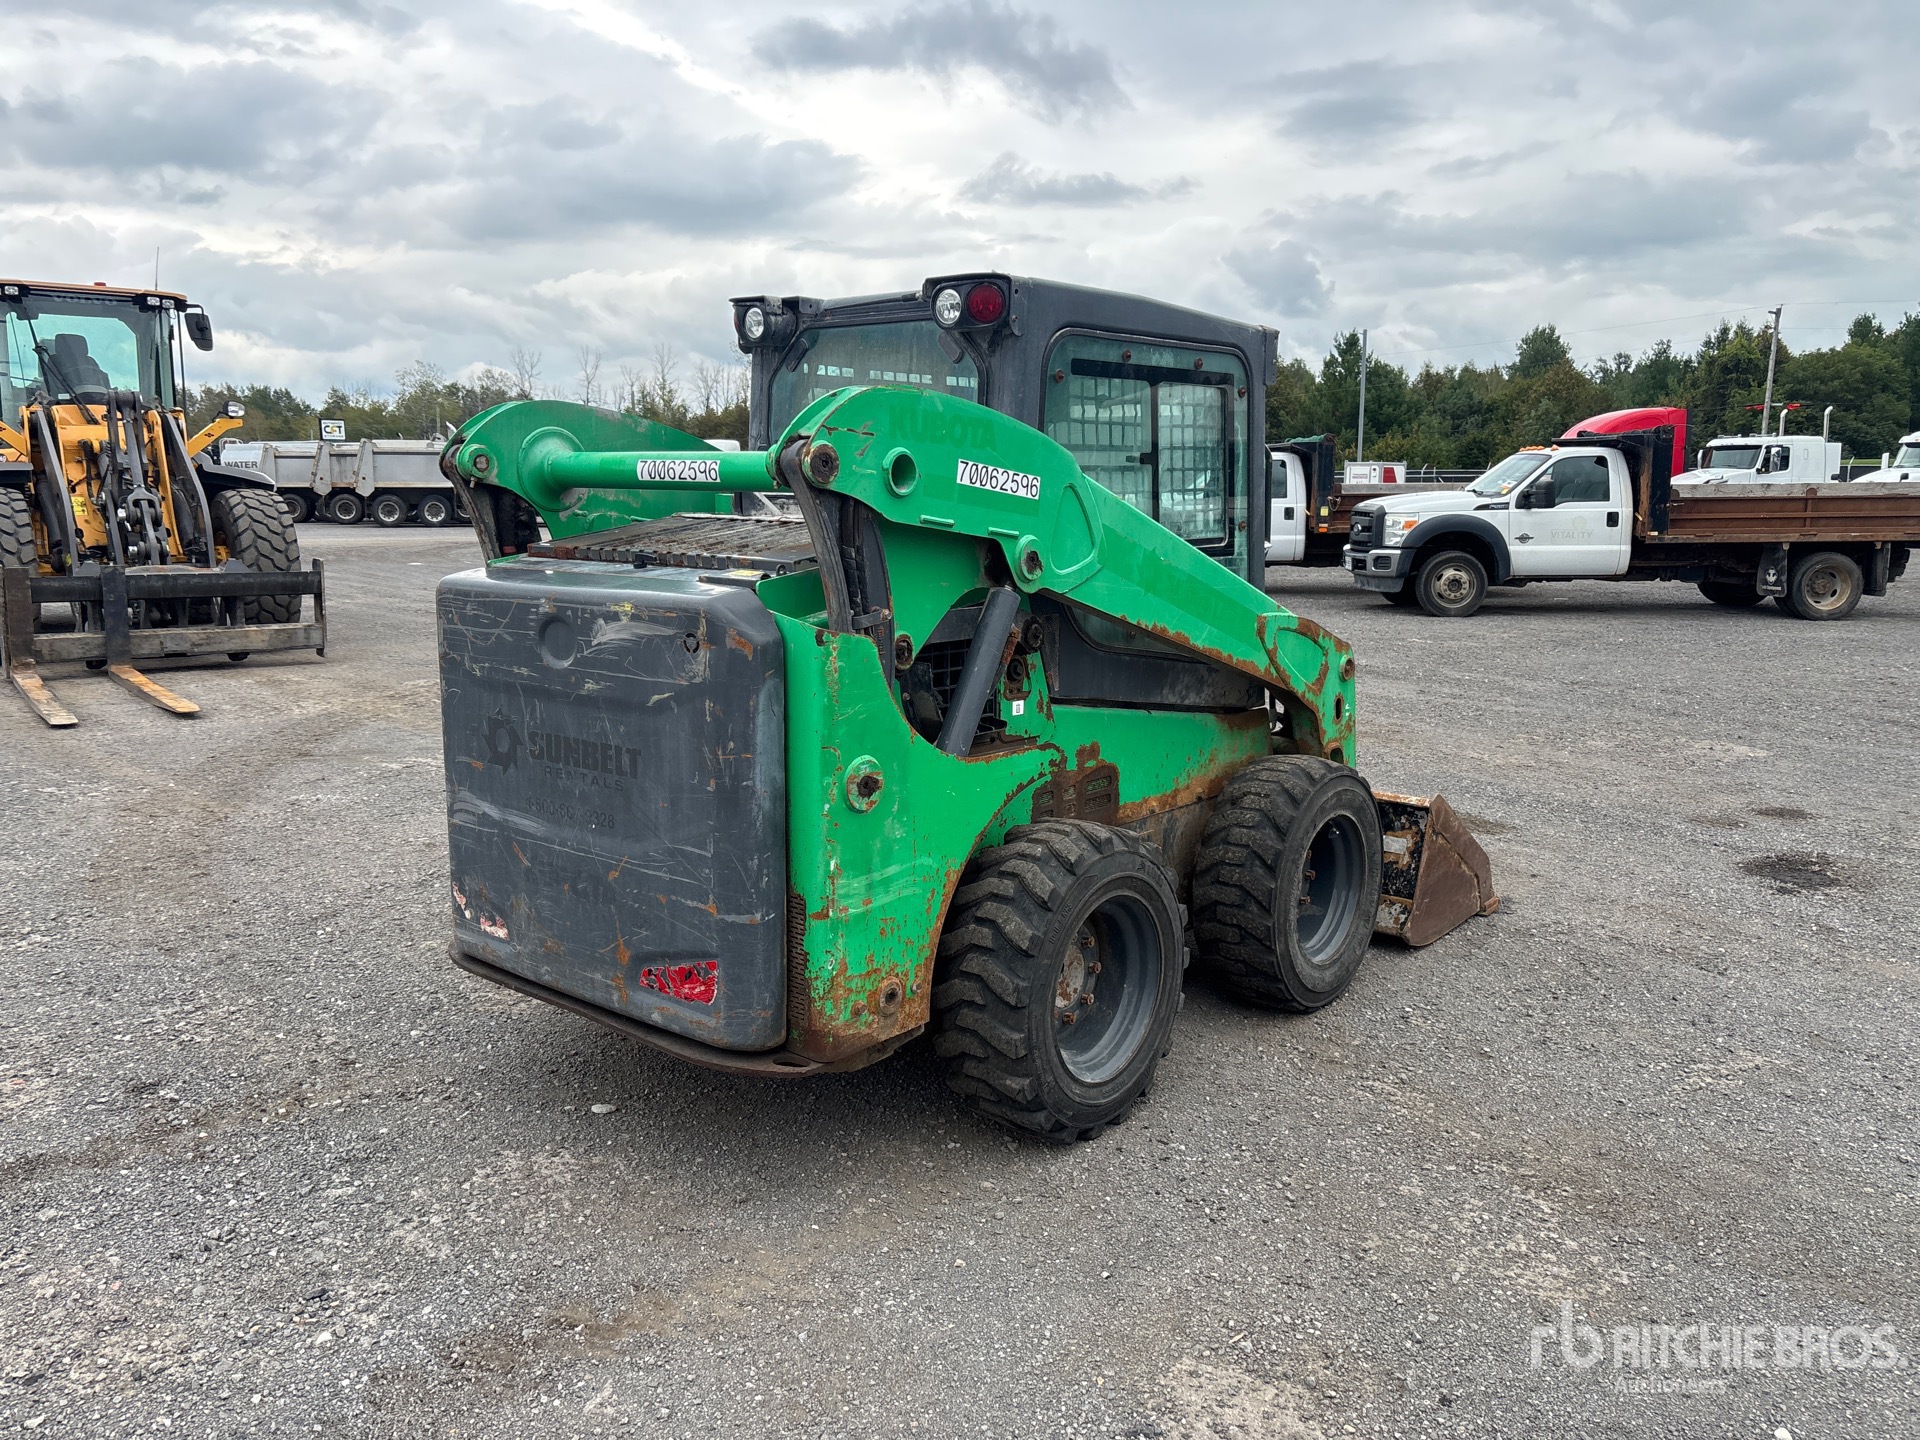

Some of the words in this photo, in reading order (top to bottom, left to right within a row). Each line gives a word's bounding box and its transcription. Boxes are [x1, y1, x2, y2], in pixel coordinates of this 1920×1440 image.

[888, 405, 998, 451] KUBOTA
[224, 461, 258, 469] WATER
[639, 460, 718, 481] 70062596
[959, 460, 1040, 498] 70062596
[1551, 531, 1593, 539] VITALITY
[527, 730, 641, 779] SUNBELT
[544, 765, 624, 792] RENTALS
